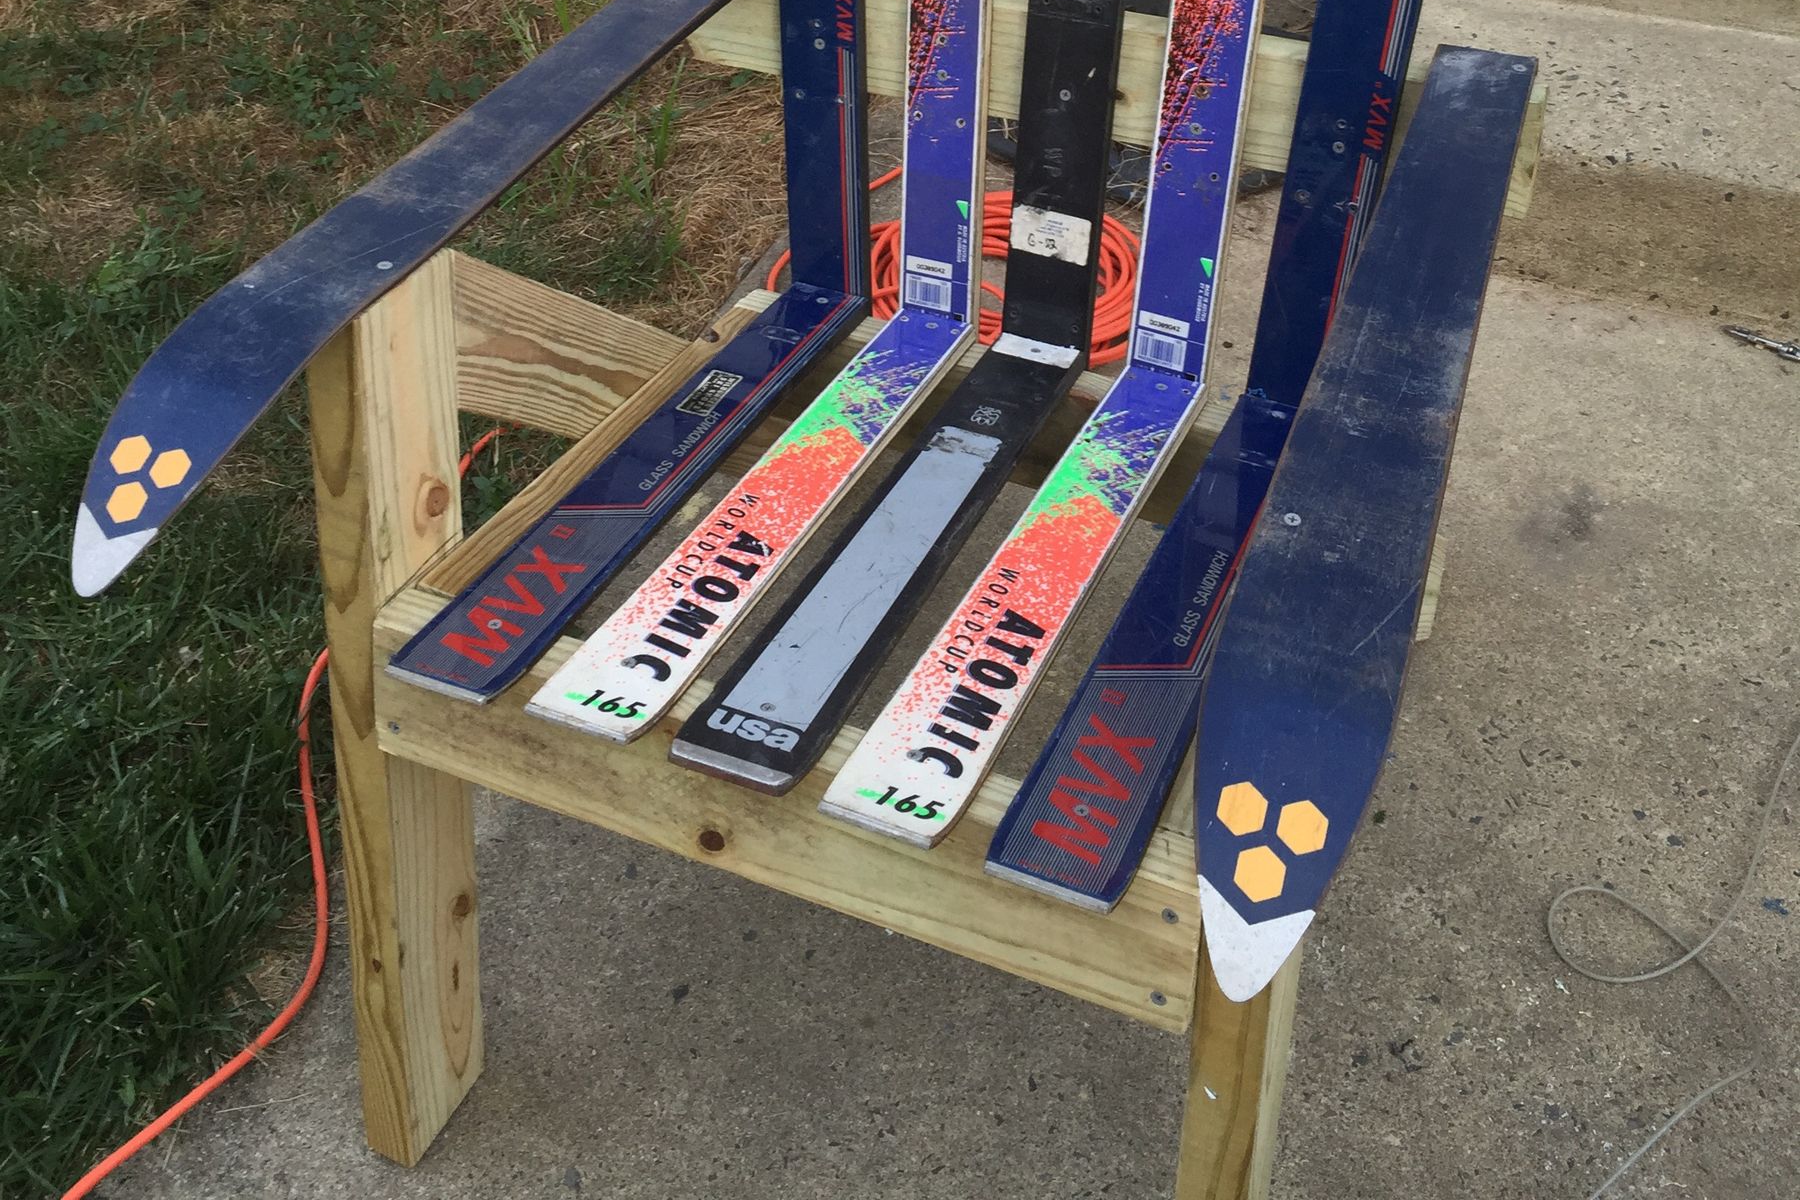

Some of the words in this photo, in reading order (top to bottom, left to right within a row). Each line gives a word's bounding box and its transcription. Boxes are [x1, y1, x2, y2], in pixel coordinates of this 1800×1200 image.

[1363, 92, 1393, 150] MVX
[637, 458, 674, 492] GLASS
[672, 411, 722, 457] SANDWICH
[666, 494, 760, 590] WORLDCUP
[440, 545, 587, 669] MVX
[629, 530, 775, 684] ATOMIC
[945, 567, 1021, 674] WORLDCUP
[1172, 608, 1202, 648] GLASS
[1198, 550, 1231, 607] SANDWICH
[580, 689, 648, 719] 165
[706, 708, 801, 753] usa
[920, 608, 1047, 780] ATOMIC
[875, 786, 945, 819] 165
[1031, 715, 1157, 865] MVX
